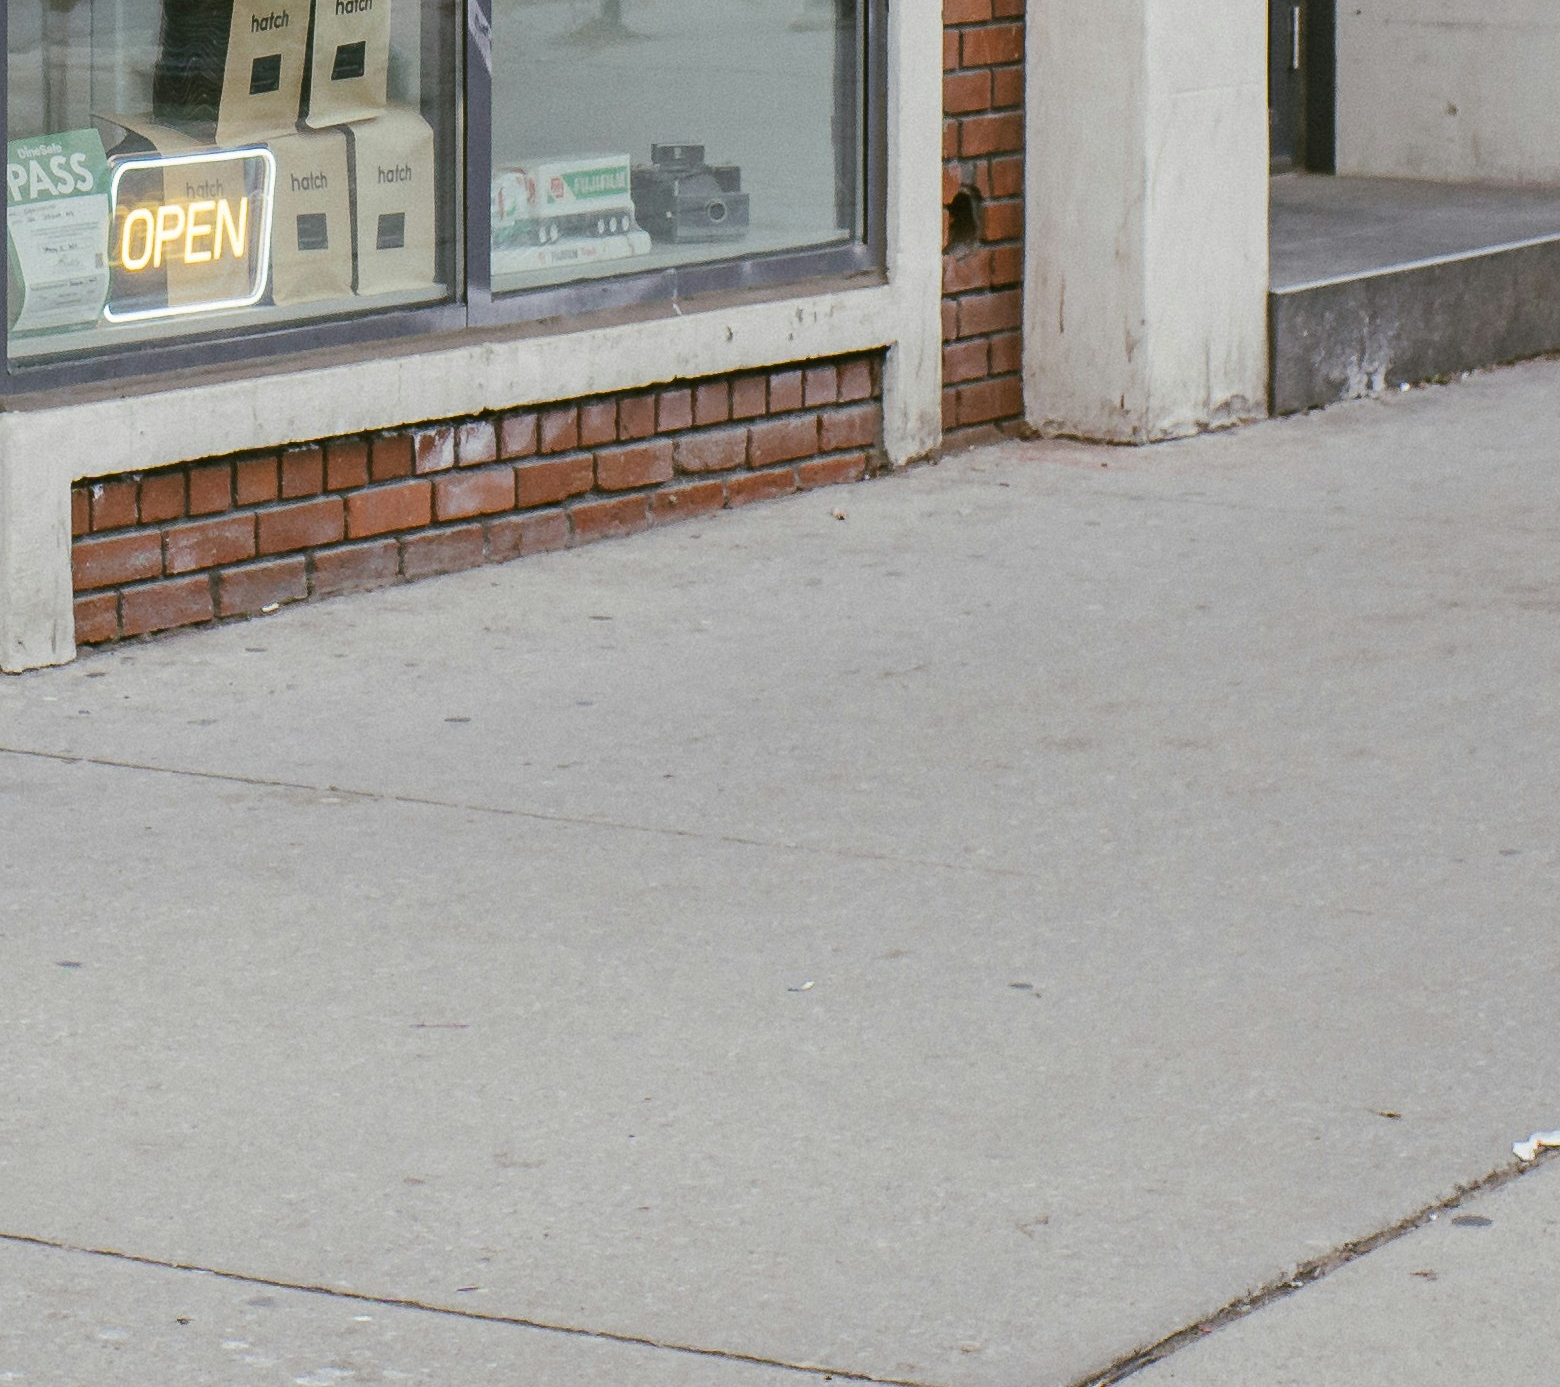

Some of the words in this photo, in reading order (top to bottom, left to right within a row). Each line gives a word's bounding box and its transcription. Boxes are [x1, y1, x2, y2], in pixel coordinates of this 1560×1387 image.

[251, 9, 289, 33] hatch
[7, 152, 94, 202] PASS
[291, 171, 328, 192] hatch
[377, 163, 412, 184] hatch
[186, 178, 224, 200] hatch
[120, 195, 249, 272] OPEN
